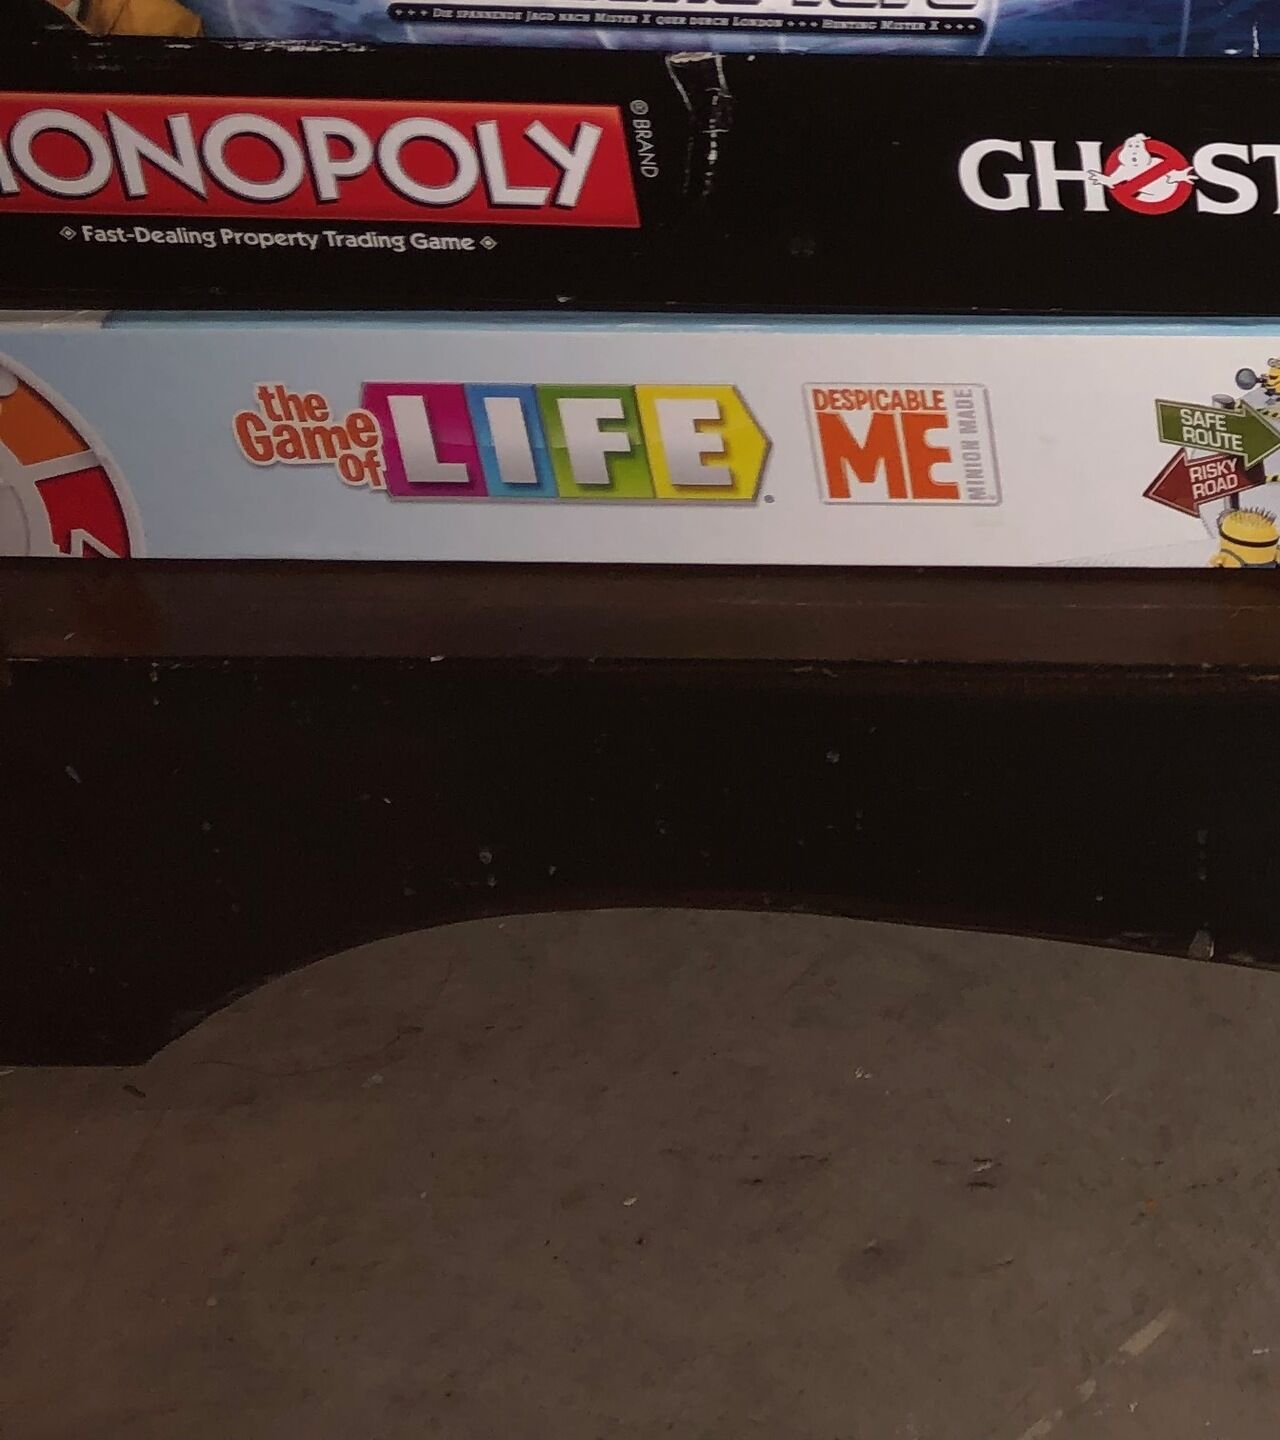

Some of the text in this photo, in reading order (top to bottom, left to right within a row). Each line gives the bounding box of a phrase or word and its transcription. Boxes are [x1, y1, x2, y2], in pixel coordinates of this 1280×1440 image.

[0, 108, 603, 208] ONOPOLY
[631, 117, 660, 180] BRAND
[82, 225, 476, 253] Fast-Dealing Property Trading Game
[257, 383, 328, 424] the
[812, 388, 948, 413] DESPICABLE
[1179, 408, 1228, 433] SAFE
[235, 410, 380, 462] Game
[387, 394, 734, 486] LIFE
[816, 411, 960, 500] ME
[959, 389, 987, 501] MINION MADE
[1181, 428, 1244, 452] ROUTE
[338, 449, 382, 488] of
[1189, 457, 1238, 483] RISKY
[1191, 475, 1239, 500] ROAD
